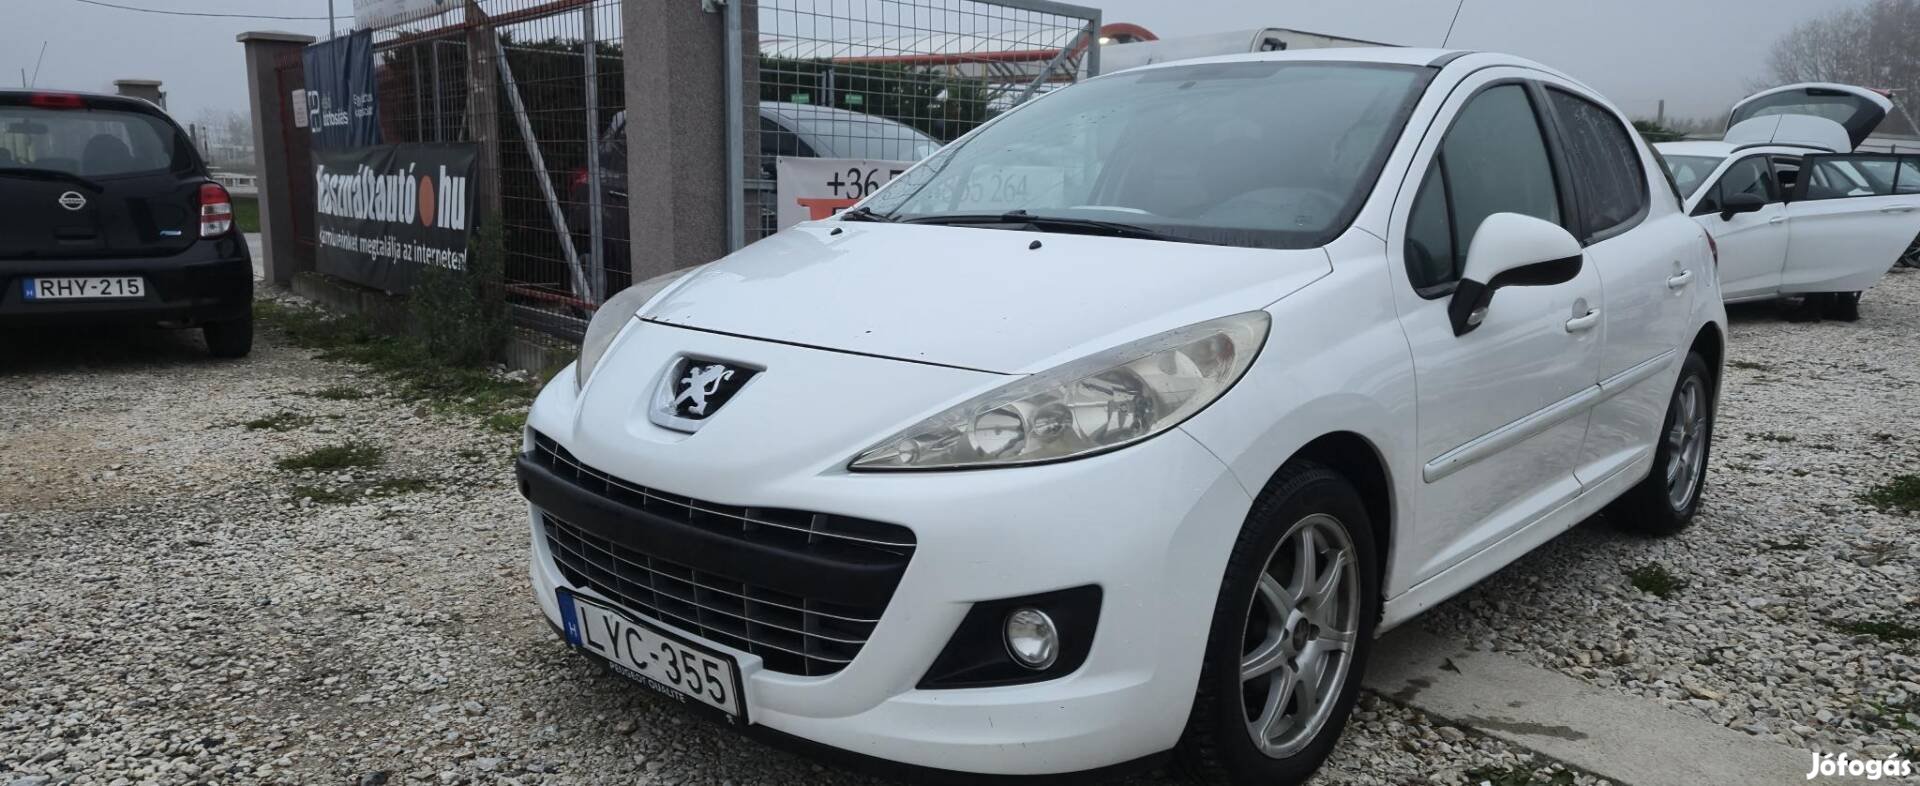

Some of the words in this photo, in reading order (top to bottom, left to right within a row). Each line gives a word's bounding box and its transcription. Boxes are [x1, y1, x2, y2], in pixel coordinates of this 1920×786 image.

[827, 167, 879, 200] +36
[403, 243, 413, 261] az
[40, 279, 140, 297] RHY-215
[580, 606, 727, 705] LYC-355
